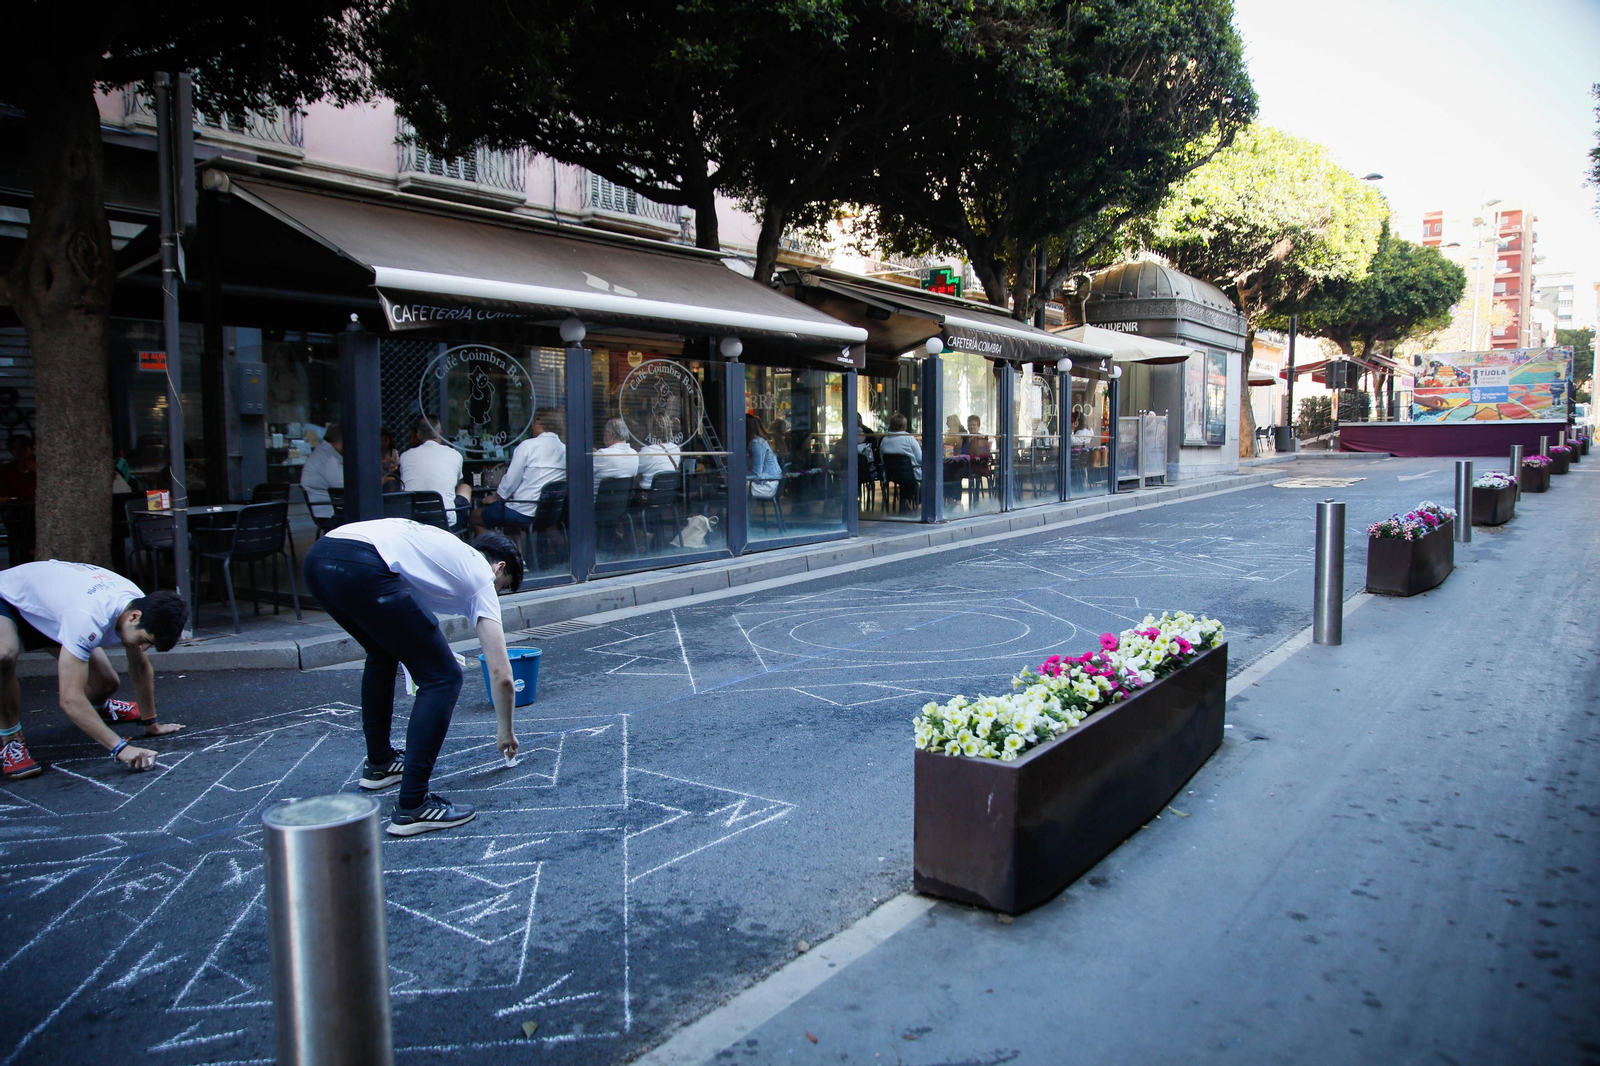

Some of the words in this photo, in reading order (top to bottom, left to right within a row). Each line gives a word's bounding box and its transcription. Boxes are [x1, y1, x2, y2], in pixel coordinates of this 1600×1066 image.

[392, 305, 472, 324] CAFETERÍA
[946, 335, 978, 351] CAFETERÍA
[978, 340, 1003, 355] COIMBRA
[434, 356, 458, 380] Café
[459, 349, 507, 371] Coimbra
[507, 362, 523, 388] Bar
[629, 368, 648, 391] Café
[647, 362, 682, 380] Coimbra
[682, 376, 695, 395] Bar
[665, 431, 684, 445] 1969
